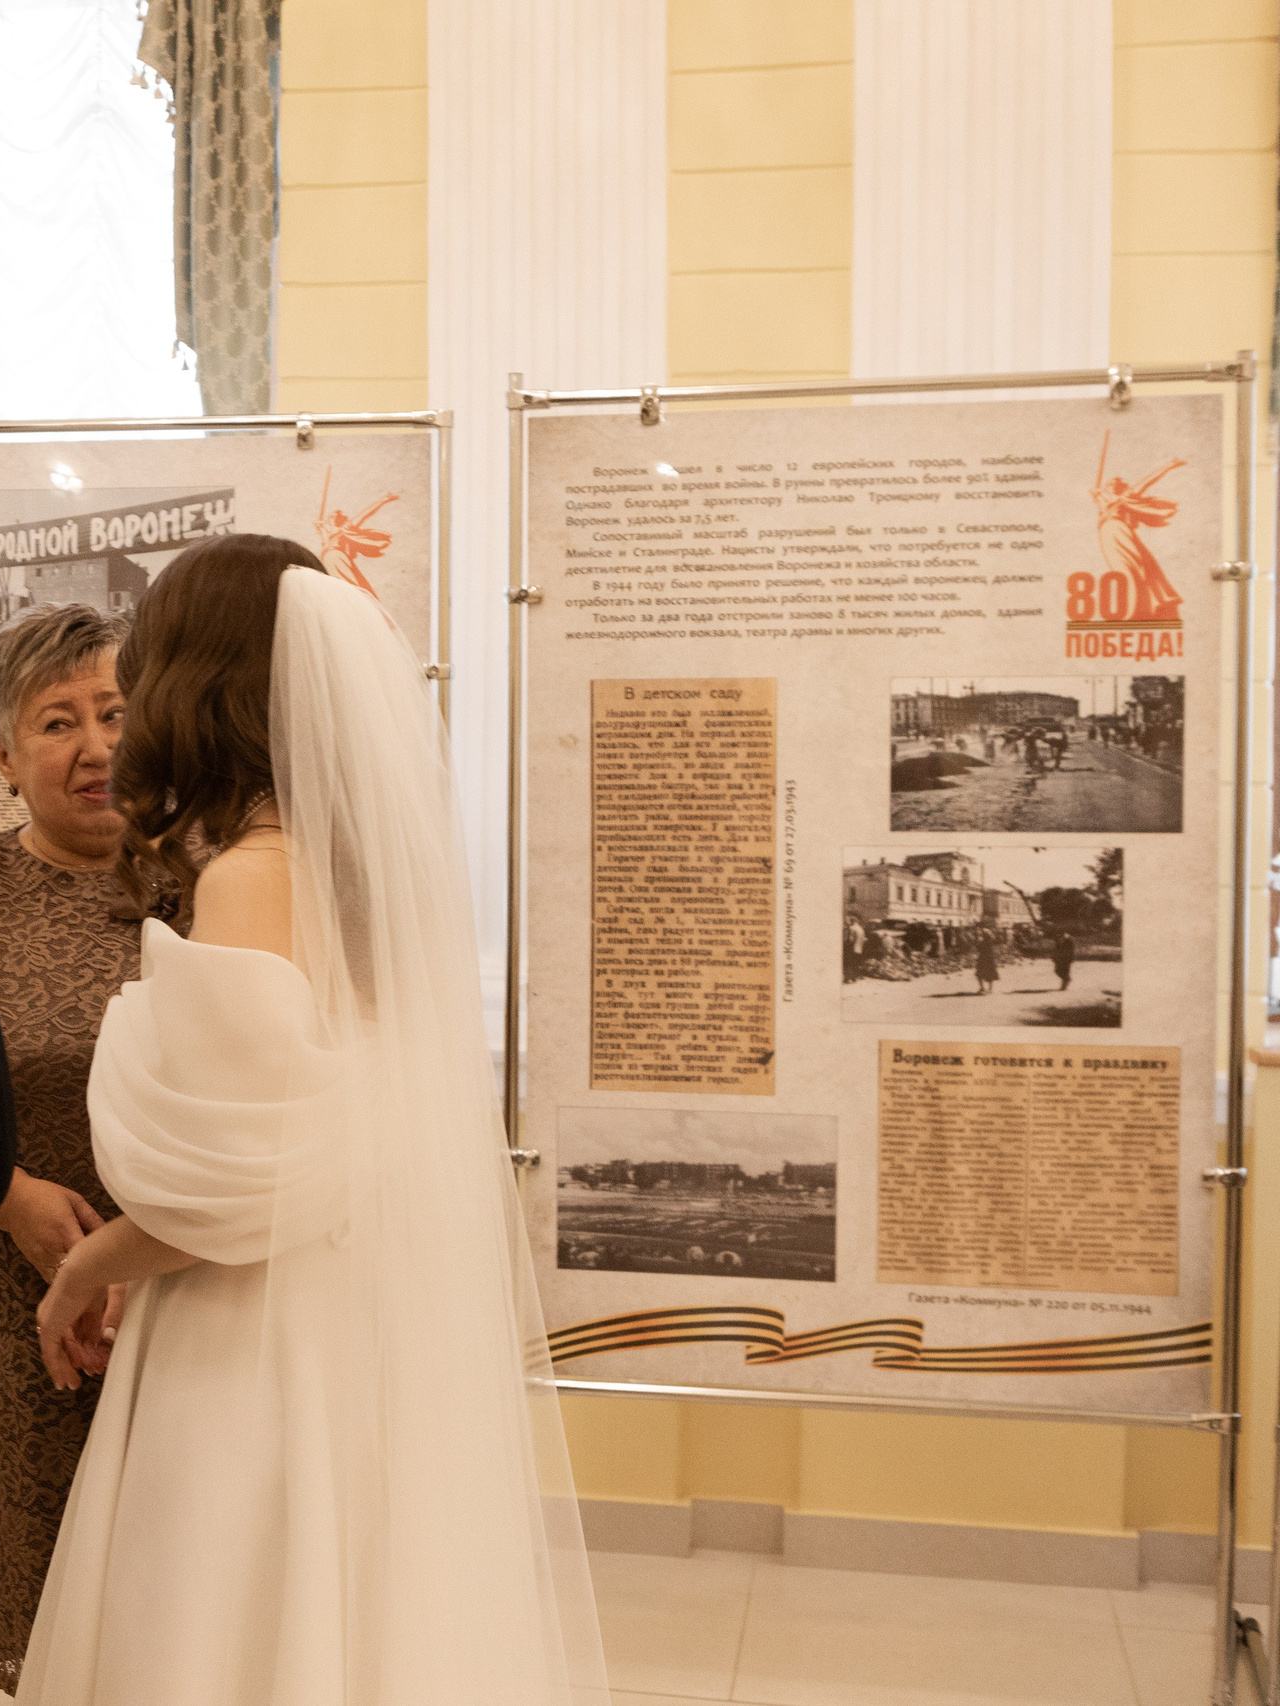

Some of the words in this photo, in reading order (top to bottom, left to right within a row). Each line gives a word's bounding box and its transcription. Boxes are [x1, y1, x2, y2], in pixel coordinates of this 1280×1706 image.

[1066, 571, 1129, 621] 80
[1065, 631, 1184, 662] ПОБЕДА!
[624, 686, 635, 700] В
[642, 688, 701, 701] детском
[709, 688, 744, 702] саду
[784, 780, 797, 838] 27.03.1943
[785, 842, 794, 856] от
[783, 859, 795, 873] 69
[782, 877, 794, 889] №
[782, 964, 794, 1003] Газета
[892, 1048, 964, 1067] Воронеж
[973, 1055, 1054, 1069] готовится
[1064, 1058, 1073, 1069] к
[1082, 1058, 1168, 1072] празднику
[908, 1292, 950, 1304] Газета
[1029, 1298, 1043, 1307] №
[1047, 1300, 1068, 1309] 220
[1071, 1302, 1086, 1310] от
